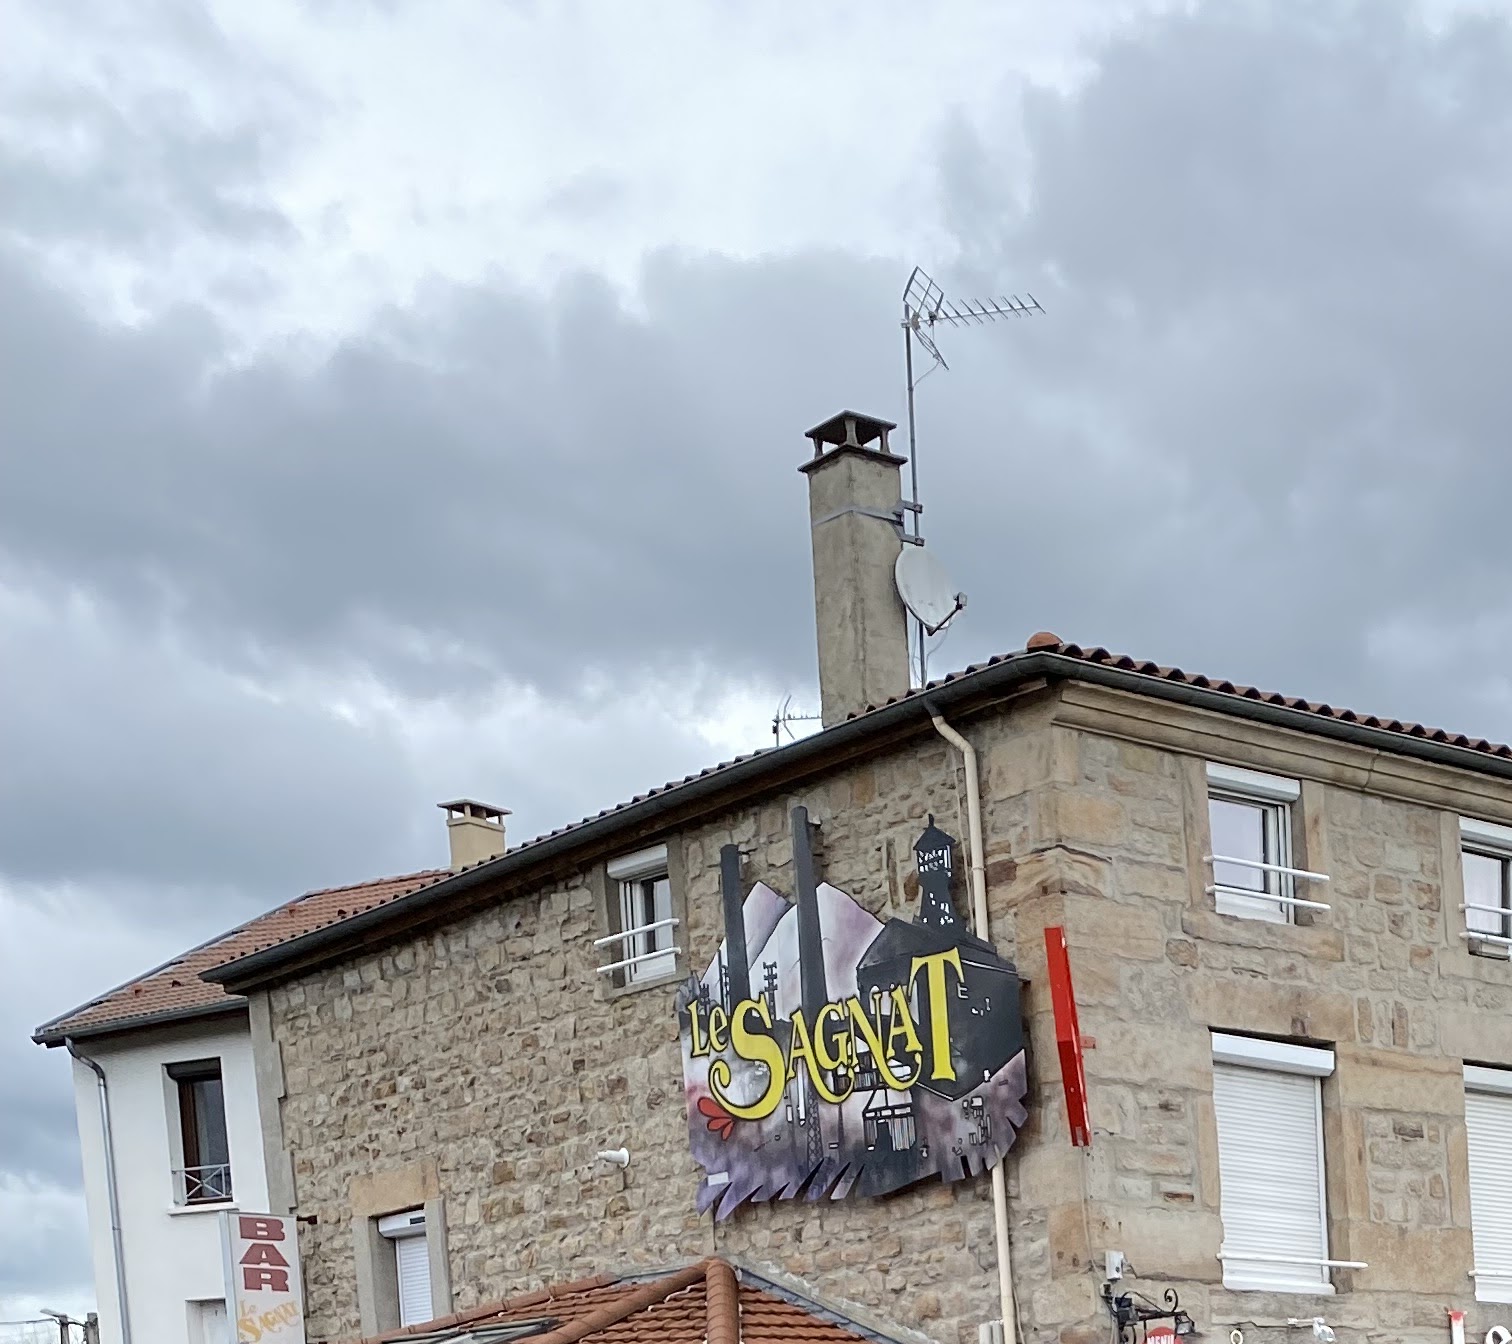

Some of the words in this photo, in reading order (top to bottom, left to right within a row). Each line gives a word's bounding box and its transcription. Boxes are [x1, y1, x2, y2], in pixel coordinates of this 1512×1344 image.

[687, 1000, 729, 1058] Le
[709, 947, 965, 1120] SAGNAT
[238, 1216, 290, 1293] BAR
